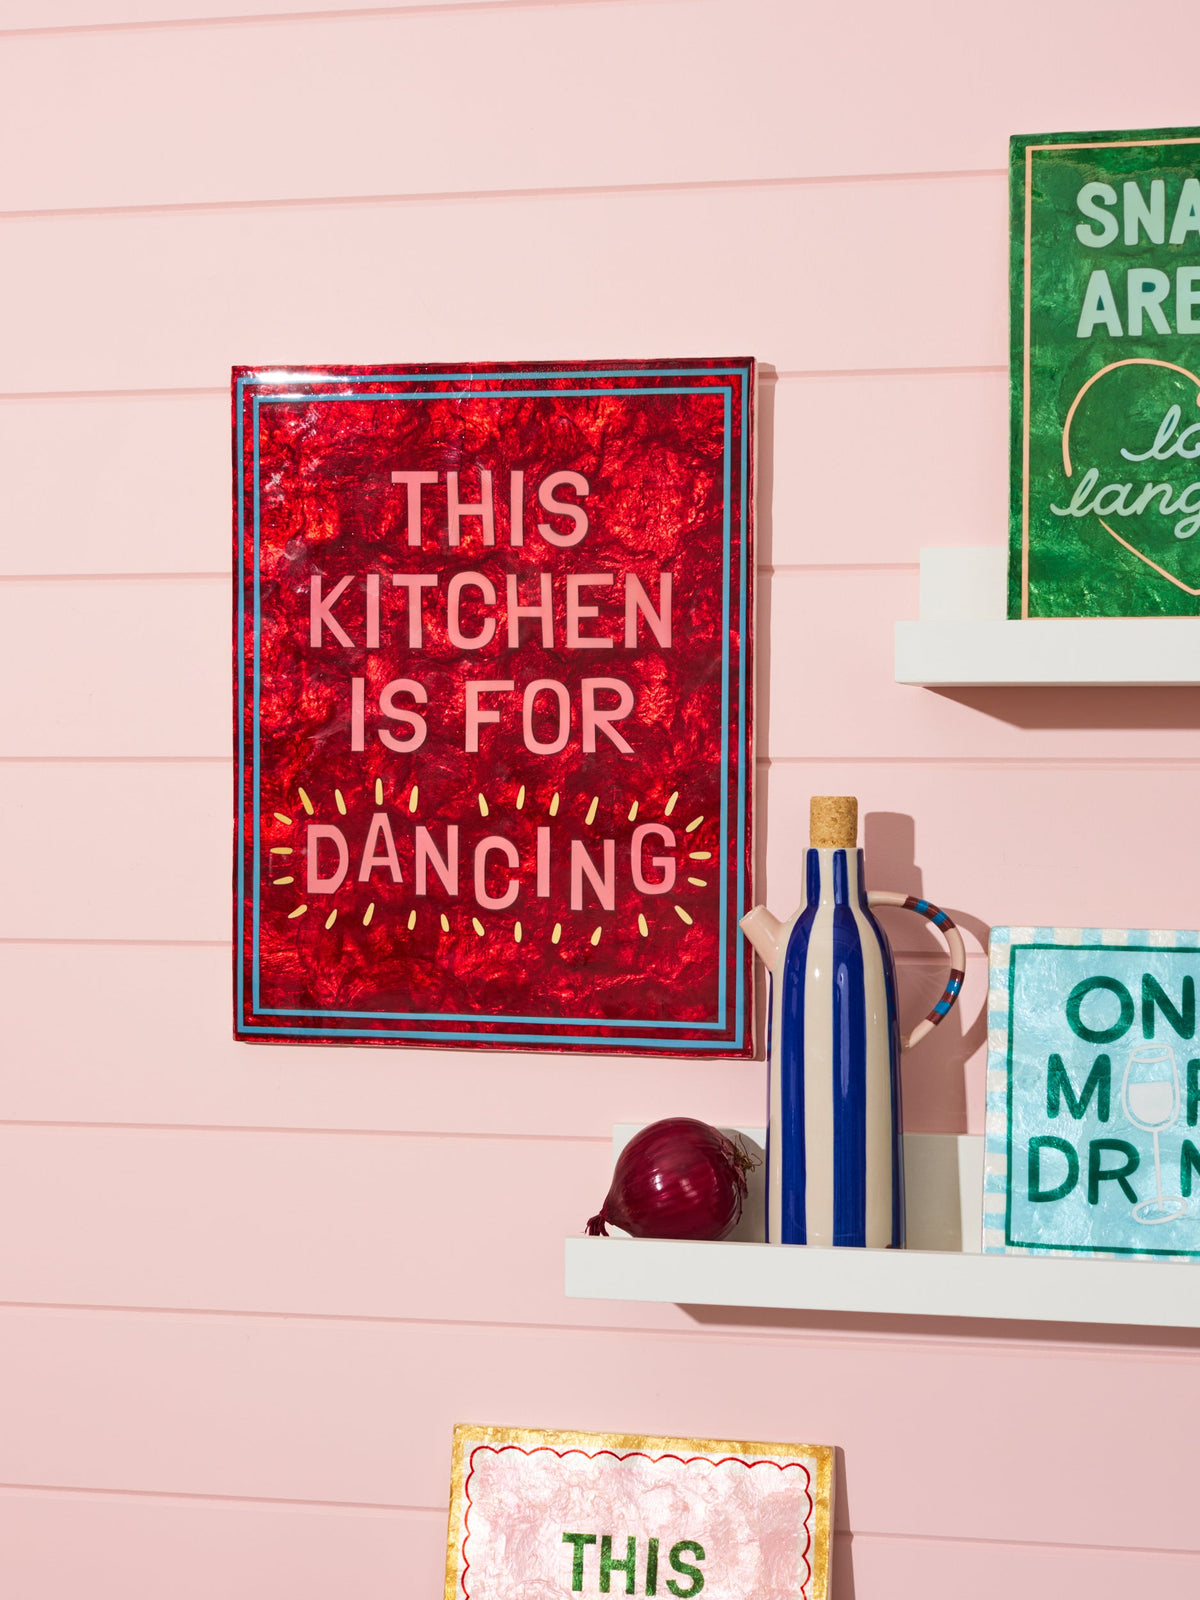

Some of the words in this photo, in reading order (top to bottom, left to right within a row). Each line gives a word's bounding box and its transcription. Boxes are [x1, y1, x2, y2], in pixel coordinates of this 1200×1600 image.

[1075, 265, 1200, 339] ARE
[391, 469, 592, 548] THIS
[309, 571, 673, 650] KITCHEN
[350, 676, 428, 754] IS
[464, 676, 636, 755] FOR
[306, 812, 678, 911] DANCING
[1065, 972, 1196, 1044] ON
[561, 1531, 706, 1599] THIS
